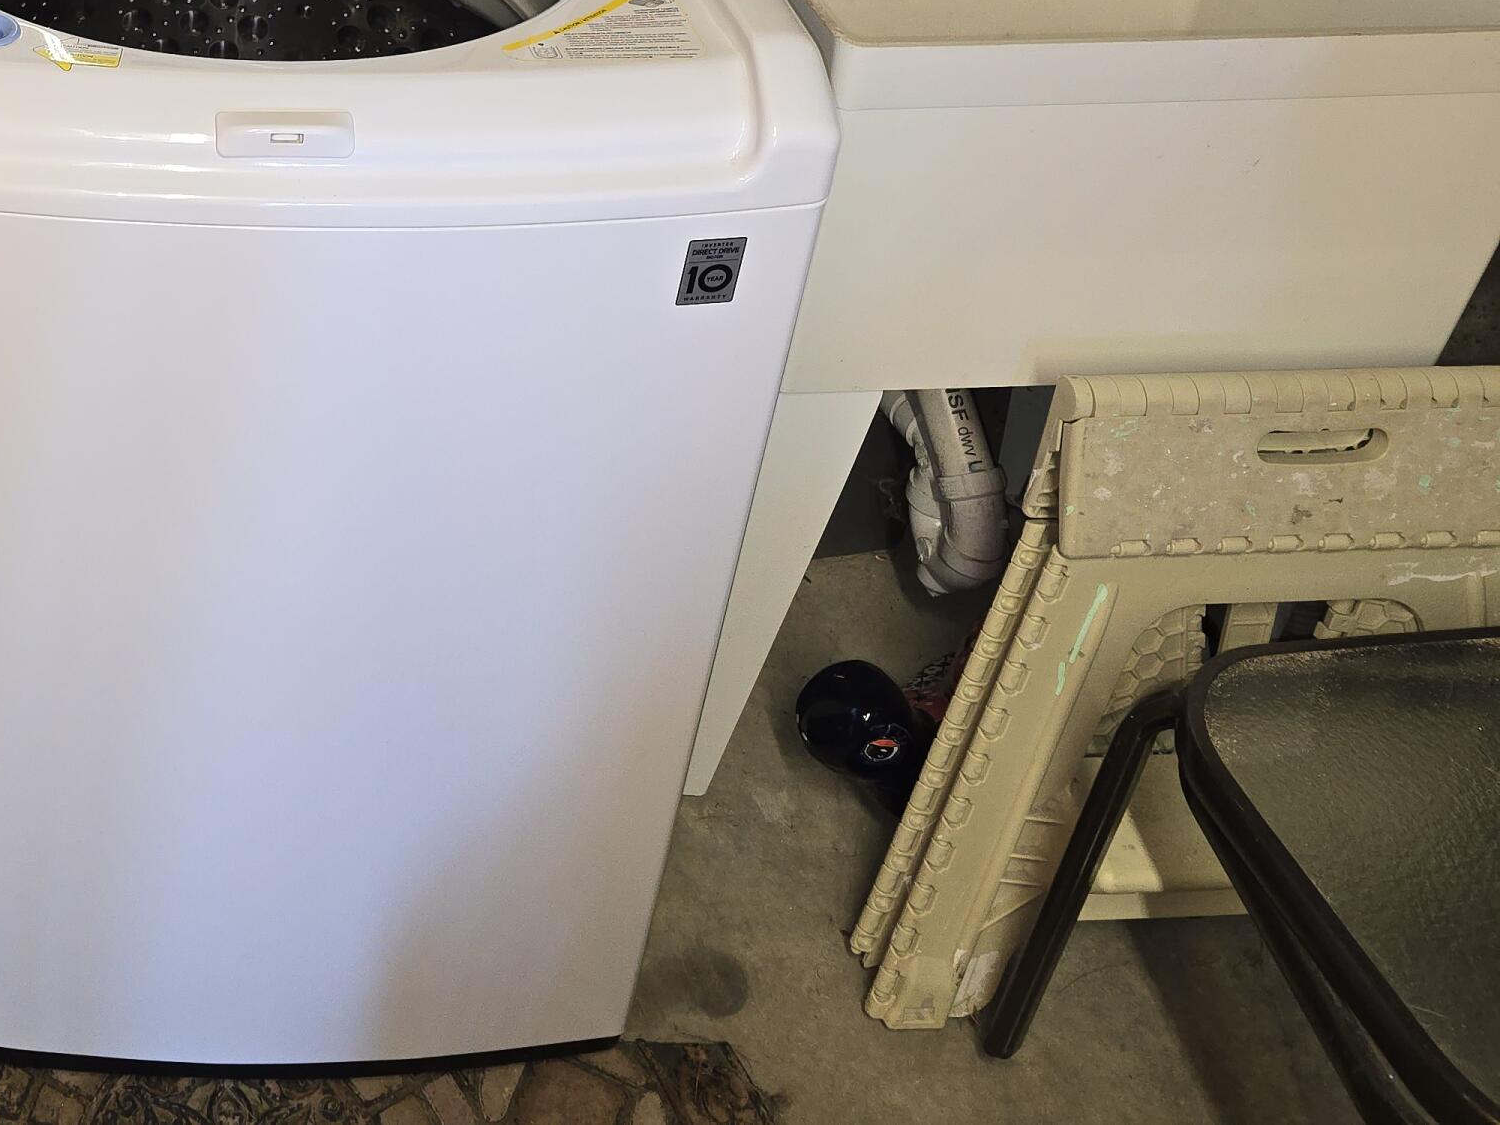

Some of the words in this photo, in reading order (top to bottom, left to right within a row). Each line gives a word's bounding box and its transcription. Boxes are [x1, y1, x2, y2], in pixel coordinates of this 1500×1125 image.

[692, 248, 719, 256] DIRECT
[718, 246, 741, 255] DRIVE
[686, 263, 733, 294] 10
[683, 294, 727, 302] WARRANTY
[945, 388, 969, 421] SF
[957, 426, 977, 457] dwv
